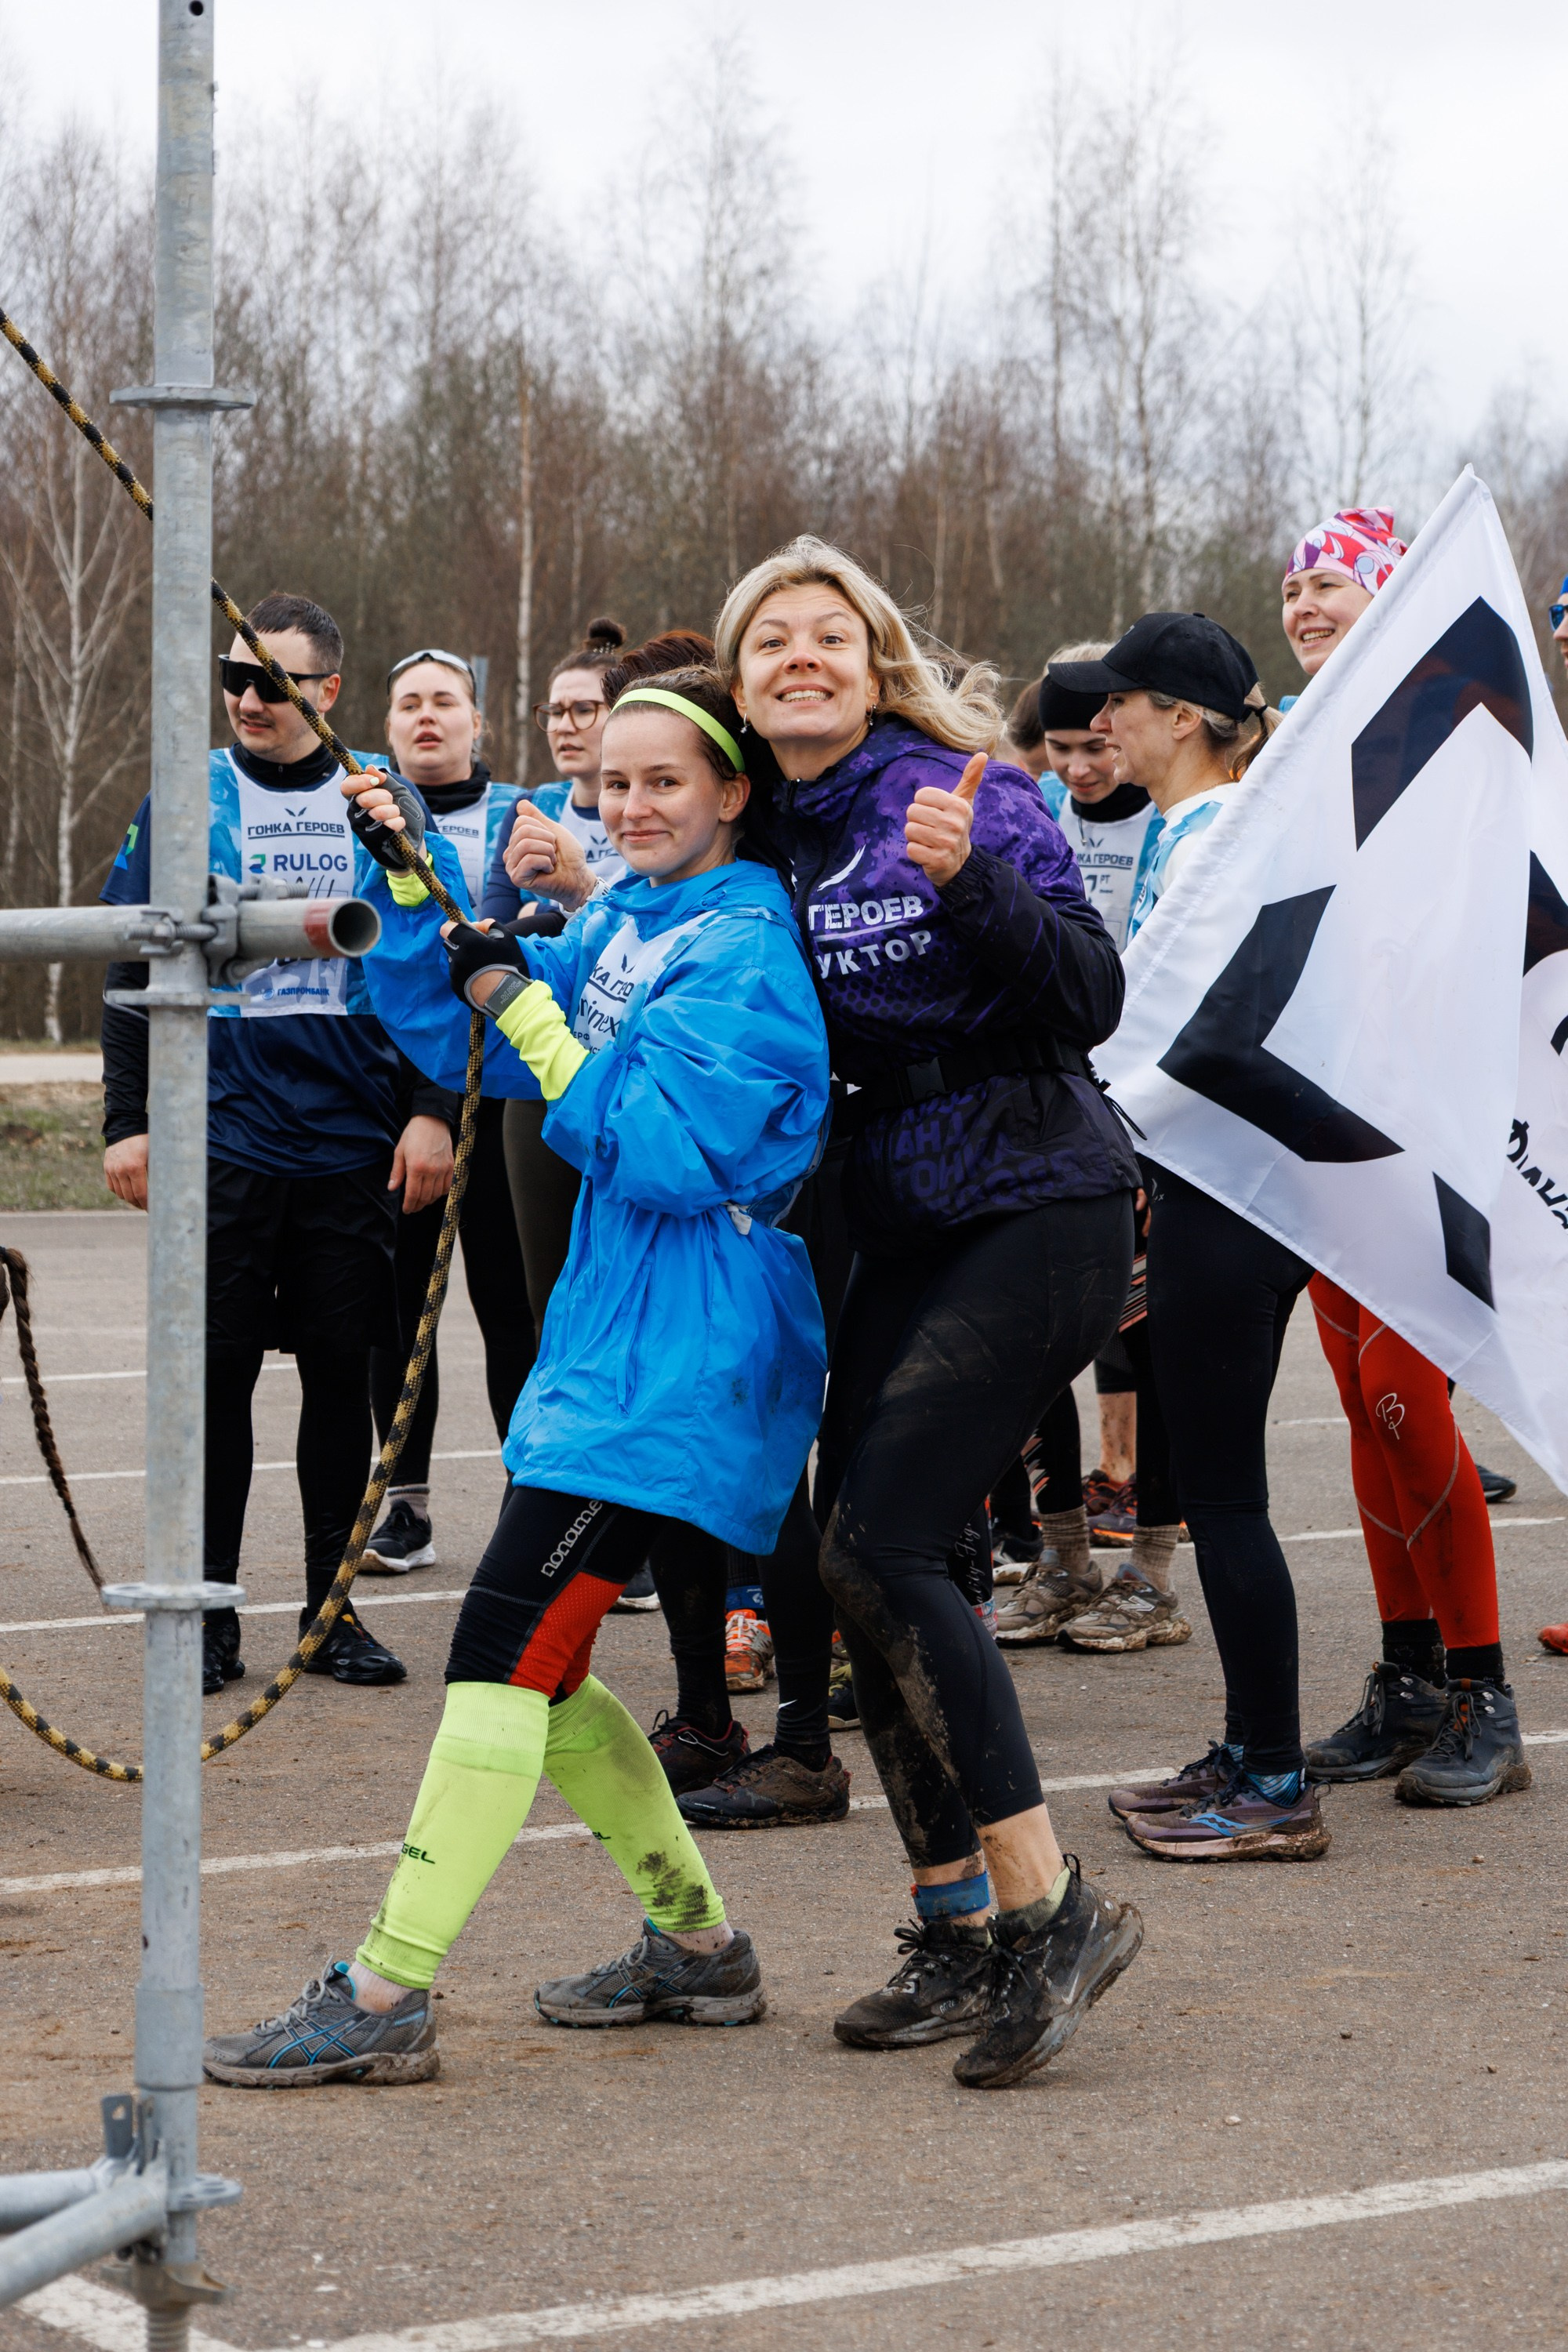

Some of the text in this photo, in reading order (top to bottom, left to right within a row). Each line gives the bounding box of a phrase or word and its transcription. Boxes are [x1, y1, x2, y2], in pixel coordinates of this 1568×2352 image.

[248, 822, 345, 836] ГОНКА ГЕРОЕВ
[437, 826, 479, 837] ЕРОЕВ
[274, 853, 348, 872] RULOG
[1094, 854, 1134, 866] ГЕРОЕВ
[808, 895, 924, 931] ГЕРОЕВ
[815, 930, 931, 979] УКТОР
[278, 988, 329, 996] ГАЗПРОМБАНК
[576, 998, 621, 1038] rinex
[540, 1499, 603, 1578] noname
